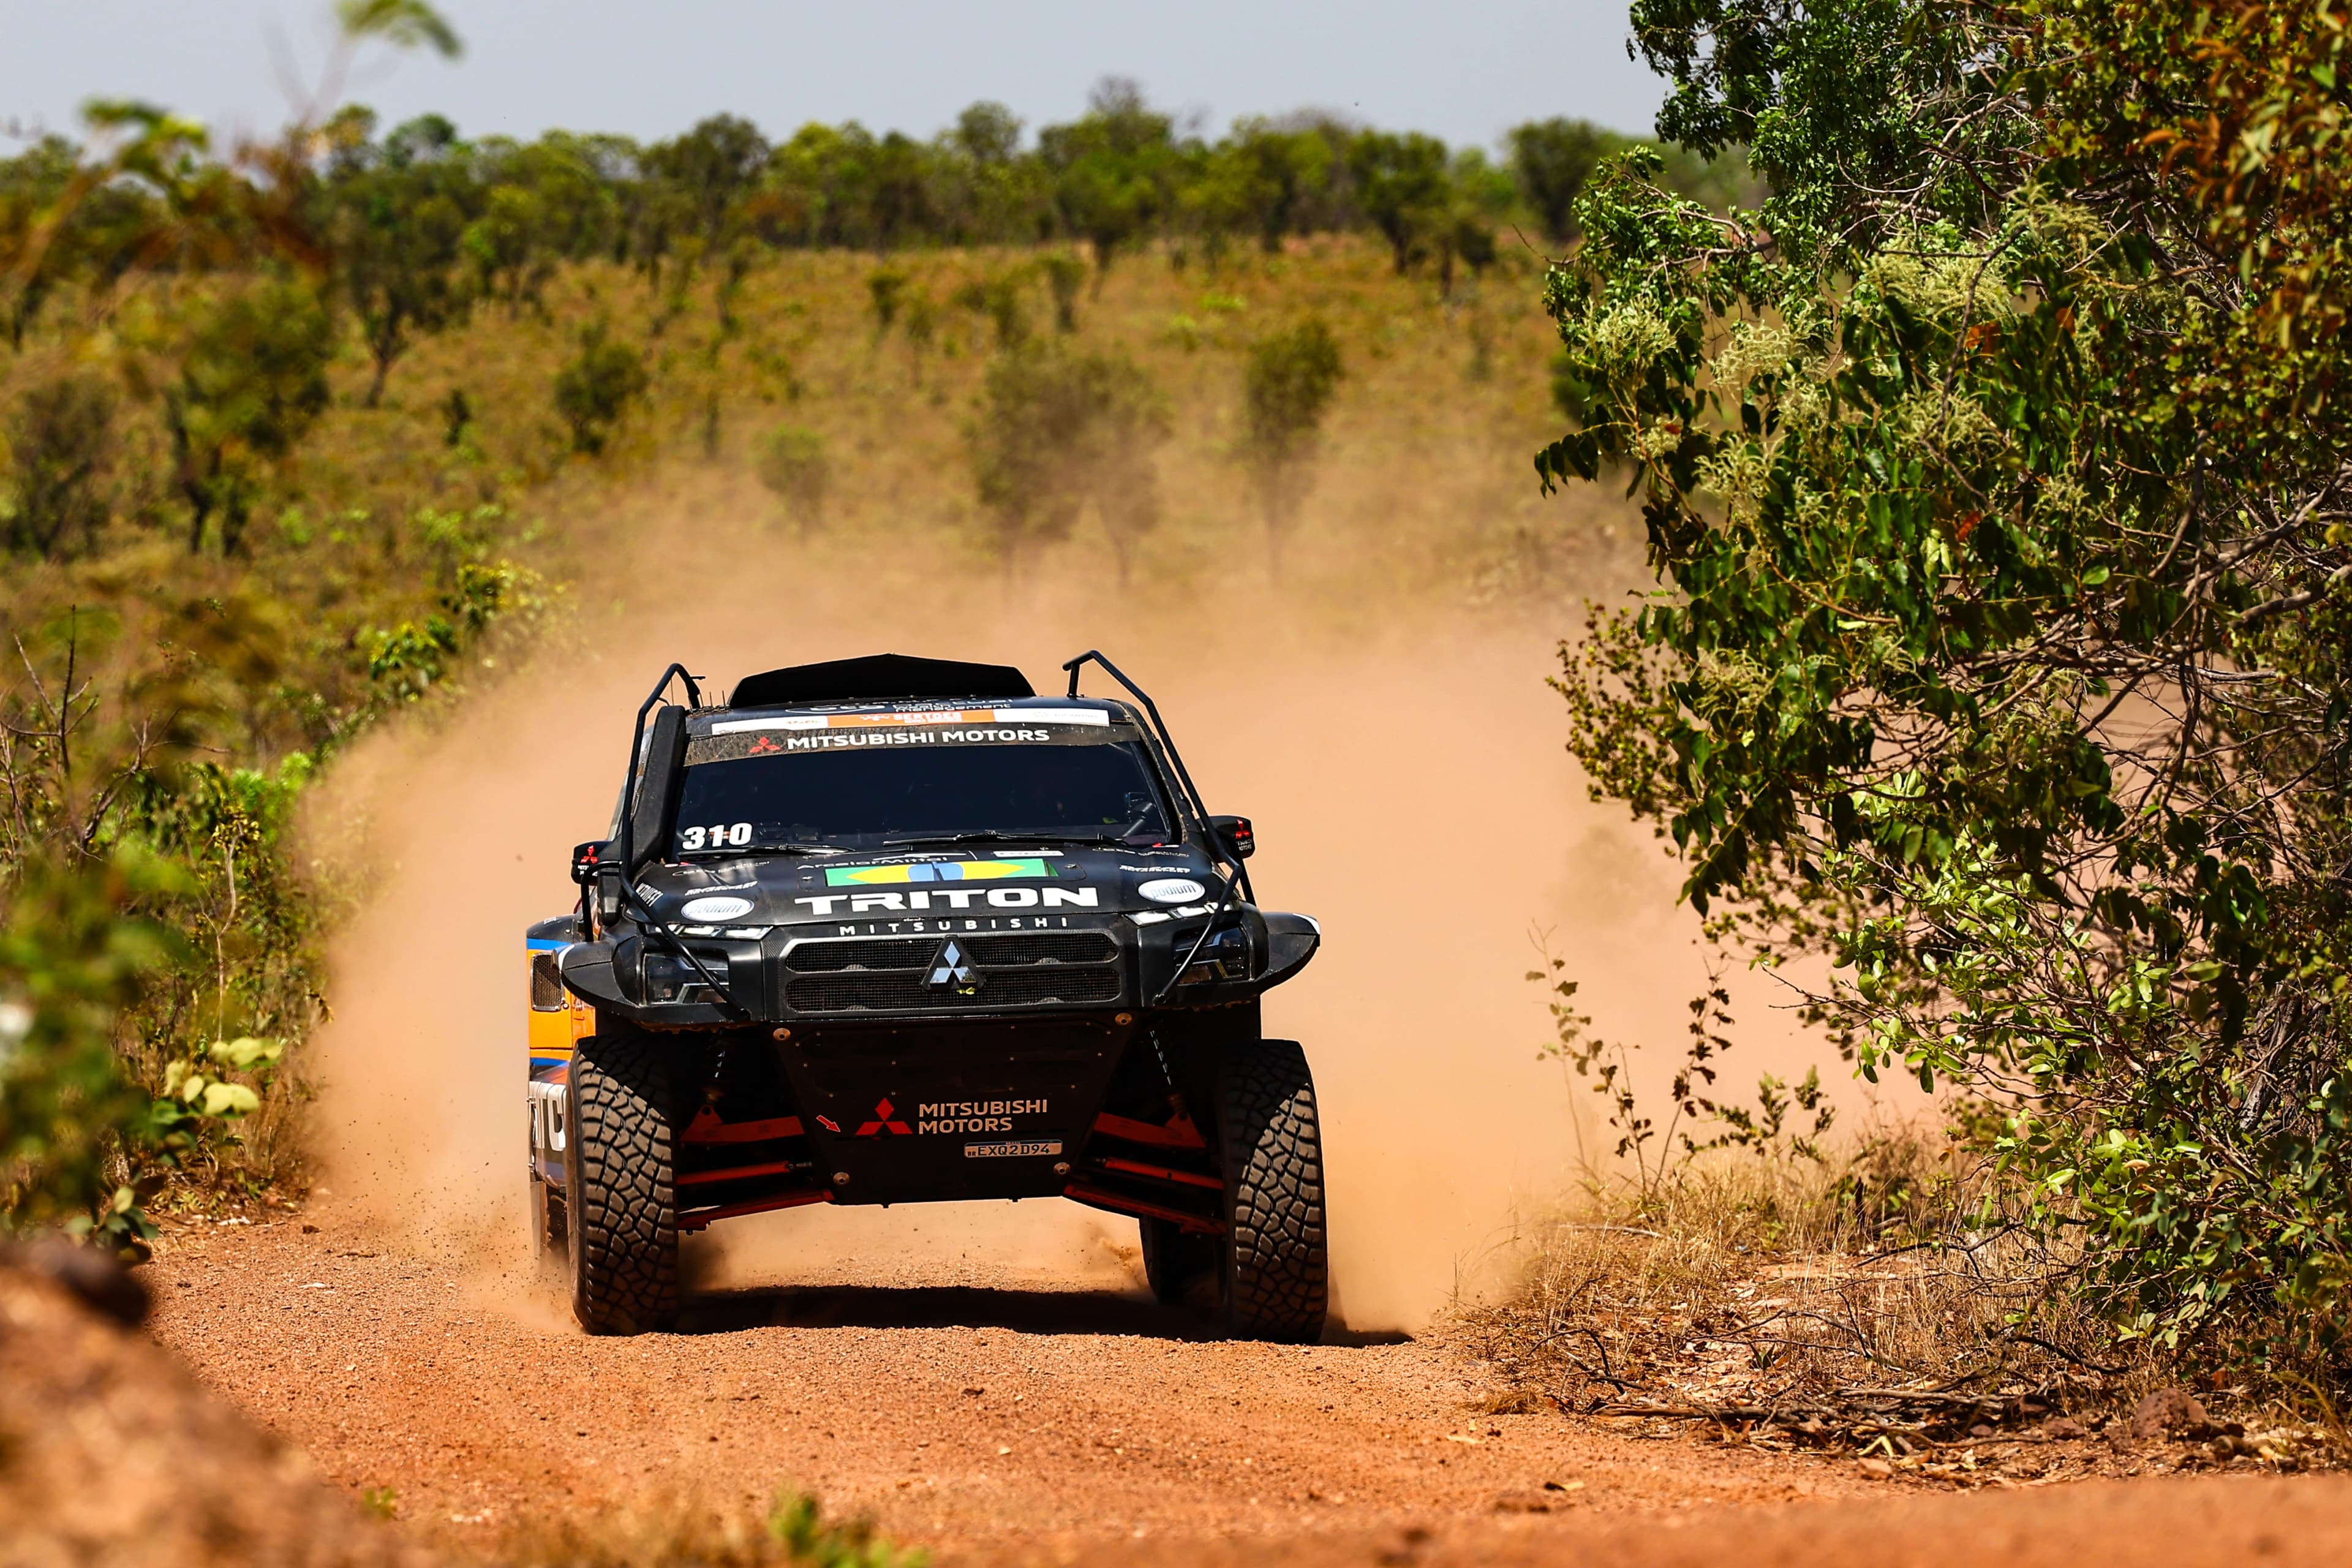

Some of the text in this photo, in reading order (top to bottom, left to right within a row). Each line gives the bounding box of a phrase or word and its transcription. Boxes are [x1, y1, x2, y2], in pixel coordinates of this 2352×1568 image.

[895, 704, 1011, 712] management
[788, 729, 1050, 750] MITSUBISHI MOTORS
[682, 822, 753, 850] 310
[797, 856, 948, 870] ArcelorMittal
[1151, 884, 1196, 900] podium
[794, 887, 1099, 916] TRITON
[839, 917, 1067, 936] MITSUBISHI
[919, 1099, 1047, 1118] MITSUBISHI
[919, 1117, 1013, 1134] MOTORS
[978, 1144, 1050, 1156] EXQ2D94
